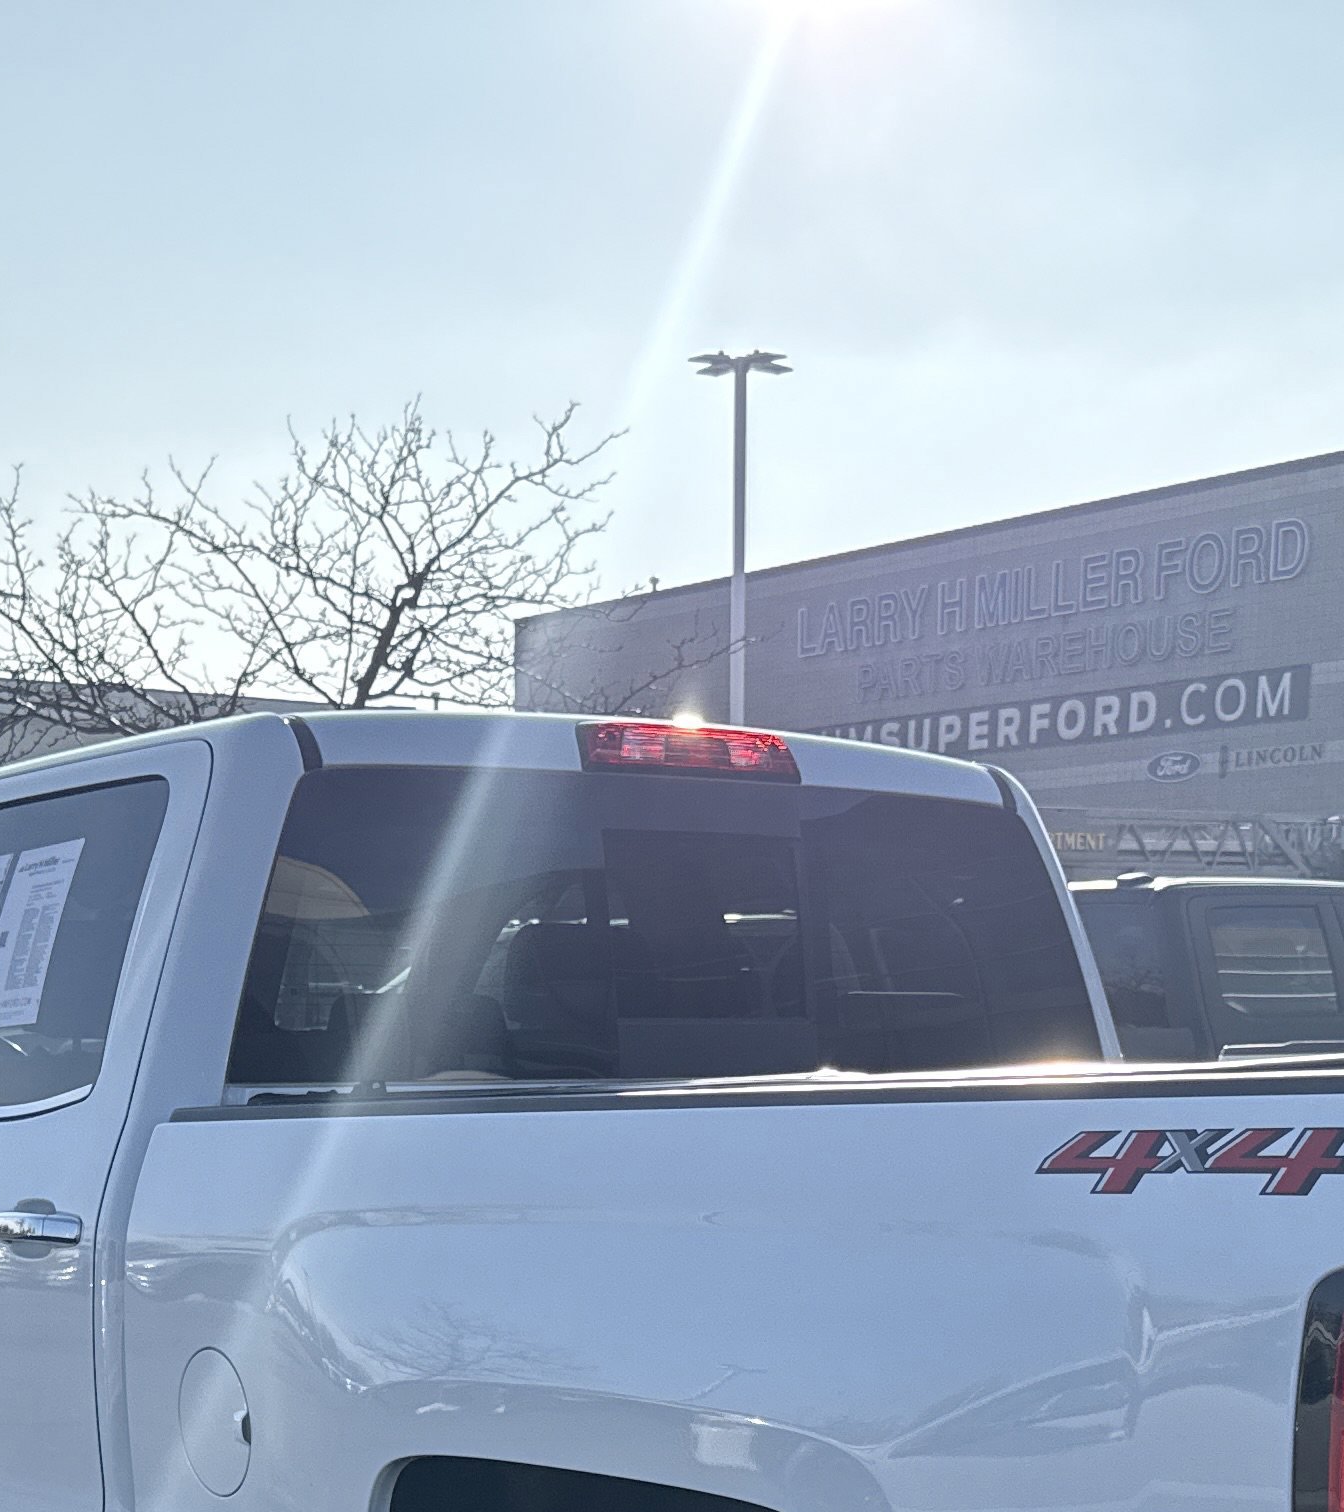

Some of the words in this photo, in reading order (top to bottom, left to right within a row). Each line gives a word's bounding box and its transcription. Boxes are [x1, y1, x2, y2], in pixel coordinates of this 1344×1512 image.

[797, 584, 928, 658] LARRY
[937, 579, 967, 635] H
[974, 548, 1144, 629] MILLER
[1155, 518, 1309, 600] FORD
[855, 650, 965, 703] PARTS
[975, 608, 1235, 685] WAREHOUSE
[1235, 744, 1326, 768] LINCOLN
